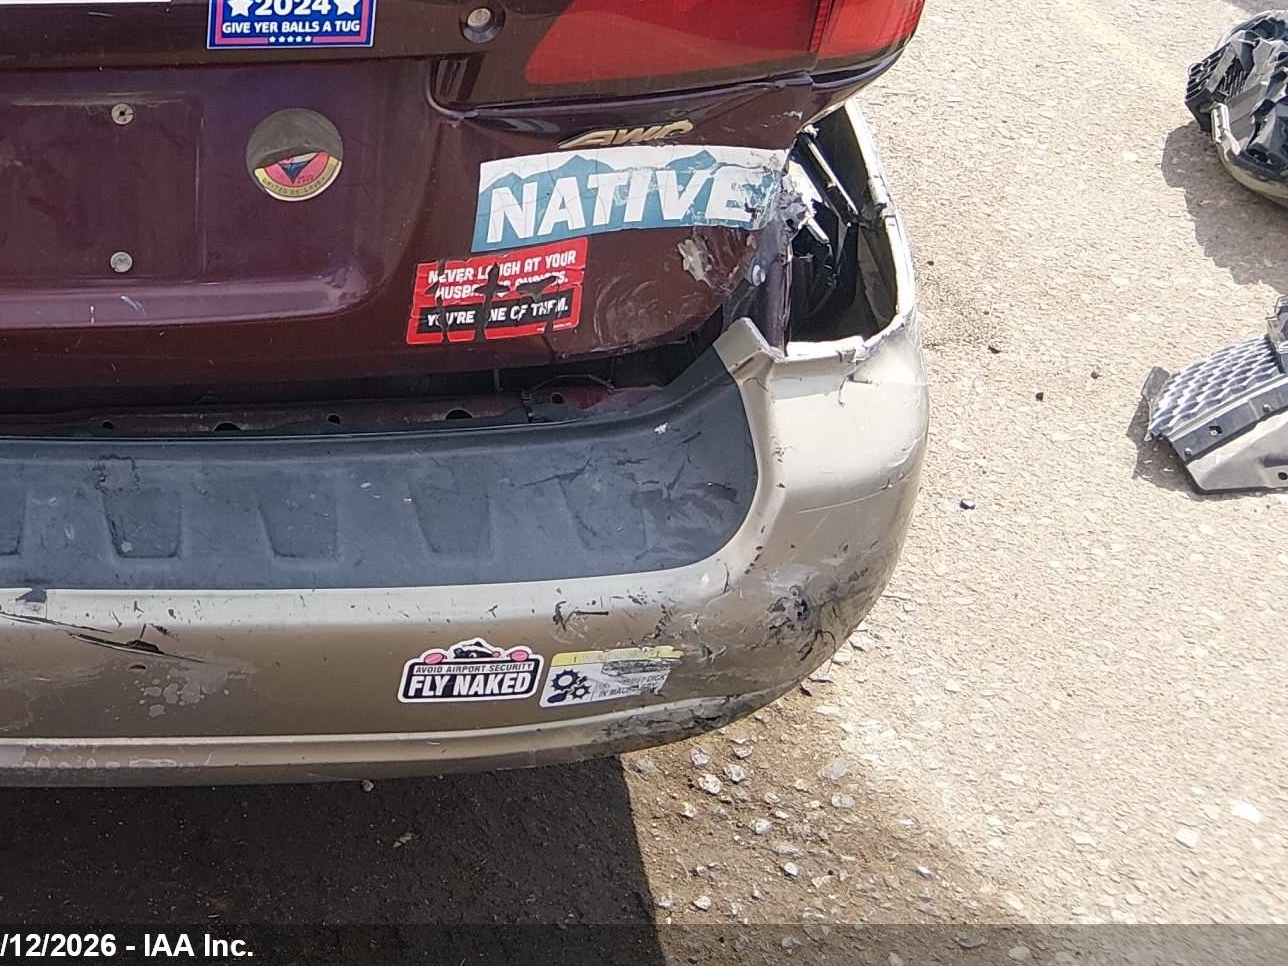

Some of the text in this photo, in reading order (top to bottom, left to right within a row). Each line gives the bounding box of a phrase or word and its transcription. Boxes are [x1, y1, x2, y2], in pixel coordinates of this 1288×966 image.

[222, 19, 361, 34] GIVE YER BALLS A TUG
[486, 166, 762, 244] NATIVE
[524, 258, 541, 274] AT
[545, 250, 576, 269] YOUR
[415, 662, 532, 674] AVOID AIRPORT SECURITY
[408, 672, 532, 697] FLY NAKED
